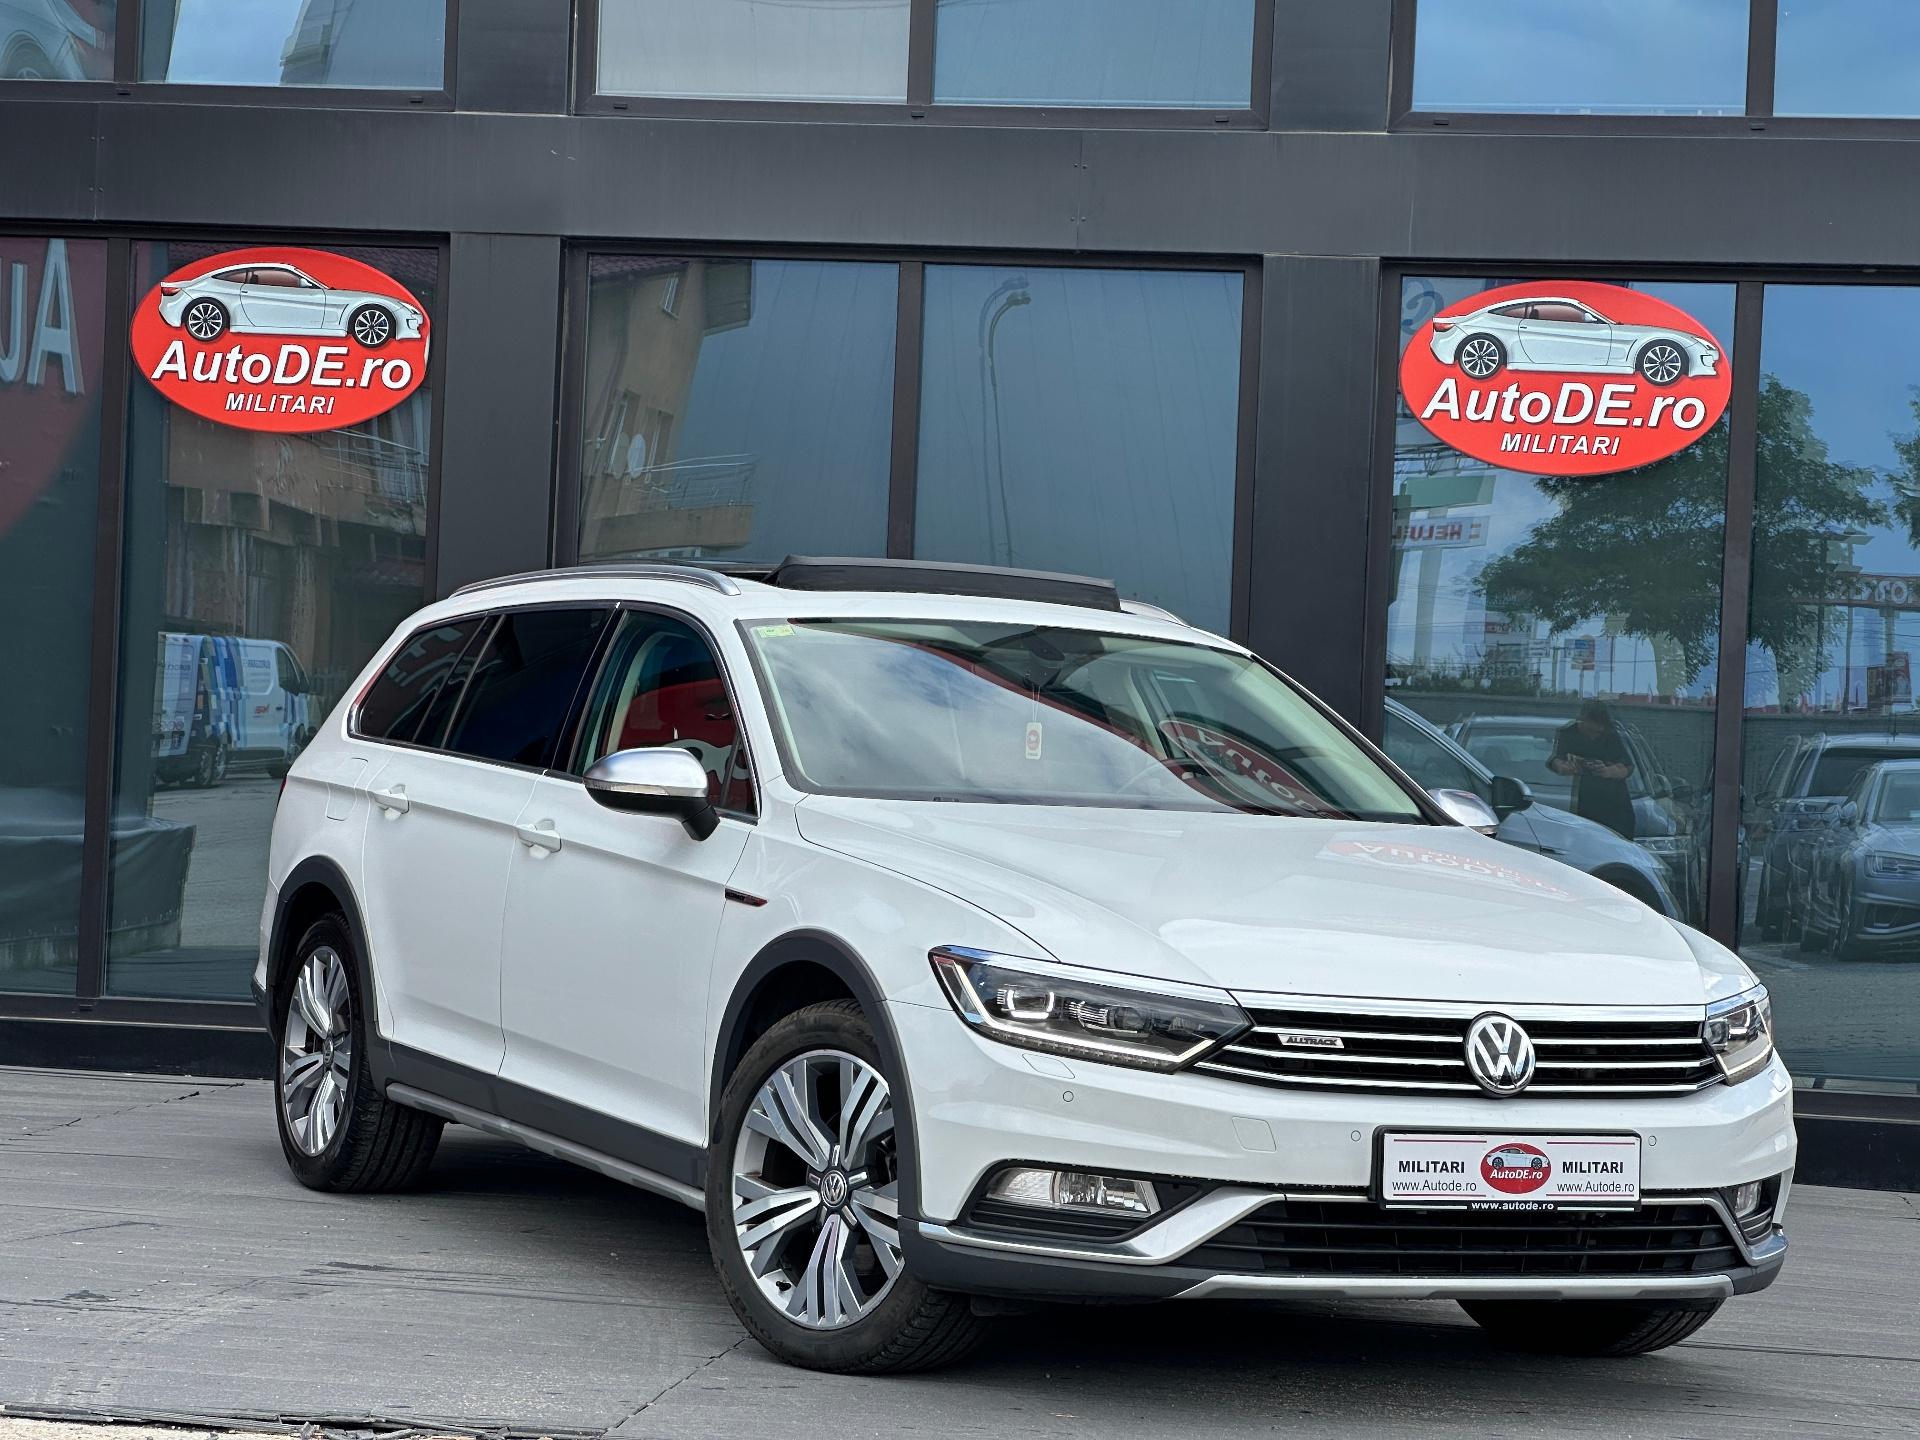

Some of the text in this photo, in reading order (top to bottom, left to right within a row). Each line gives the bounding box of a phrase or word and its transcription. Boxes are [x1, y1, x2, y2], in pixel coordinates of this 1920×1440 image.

[151, 340, 413, 389] AutoDE.ro
[225, 392, 335, 415] MILITARI
[1421, 378, 1706, 430] AutoDE.ro
[1500, 433, 1620, 456] MILITARI
[1286, 1035, 1338, 1046] ALLTRACK
[1398, 1160, 1465, 1174] MILITARI
[1562, 1161, 1624, 1174] MILITARI
[1490, 1169, 1543, 1180] AutoDE.ro
[1392, 1179, 1477, 1192] www.Autode.ro
[1557, 1180, 1635, 1193] www.Autode.ro
[1471, 1201, 1555, 1211] www.autode.ro
